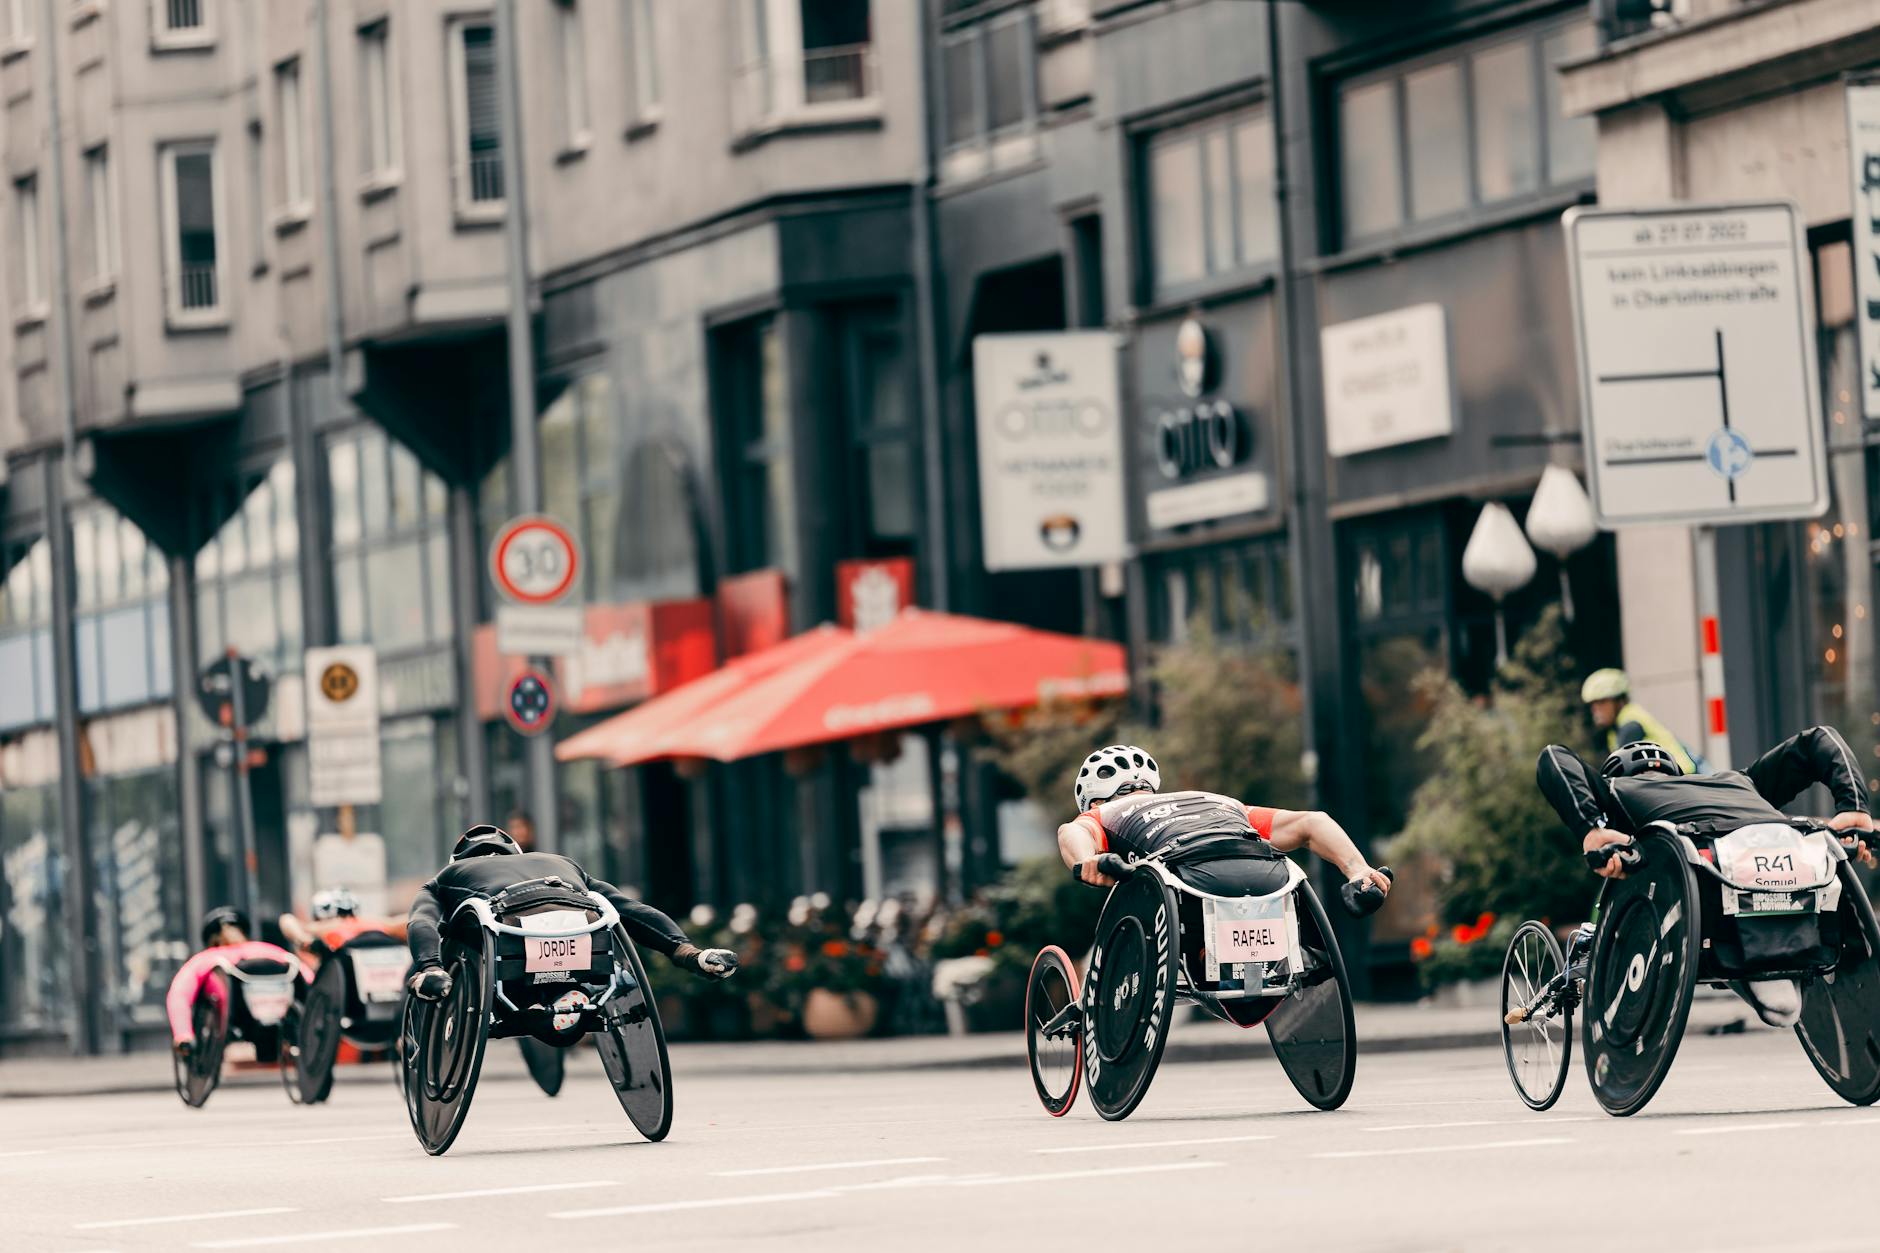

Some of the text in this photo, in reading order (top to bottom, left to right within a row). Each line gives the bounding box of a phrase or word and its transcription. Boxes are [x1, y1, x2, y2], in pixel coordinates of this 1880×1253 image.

[515, 544, 560, 579] 30
[1754, 854, 1794, 873] R41
[1232, 928, 1275, 947] RAFAEL
[538, 939, 576, 960] JORDIE
[1144, 903, 1169, 1052] QUICKIE
